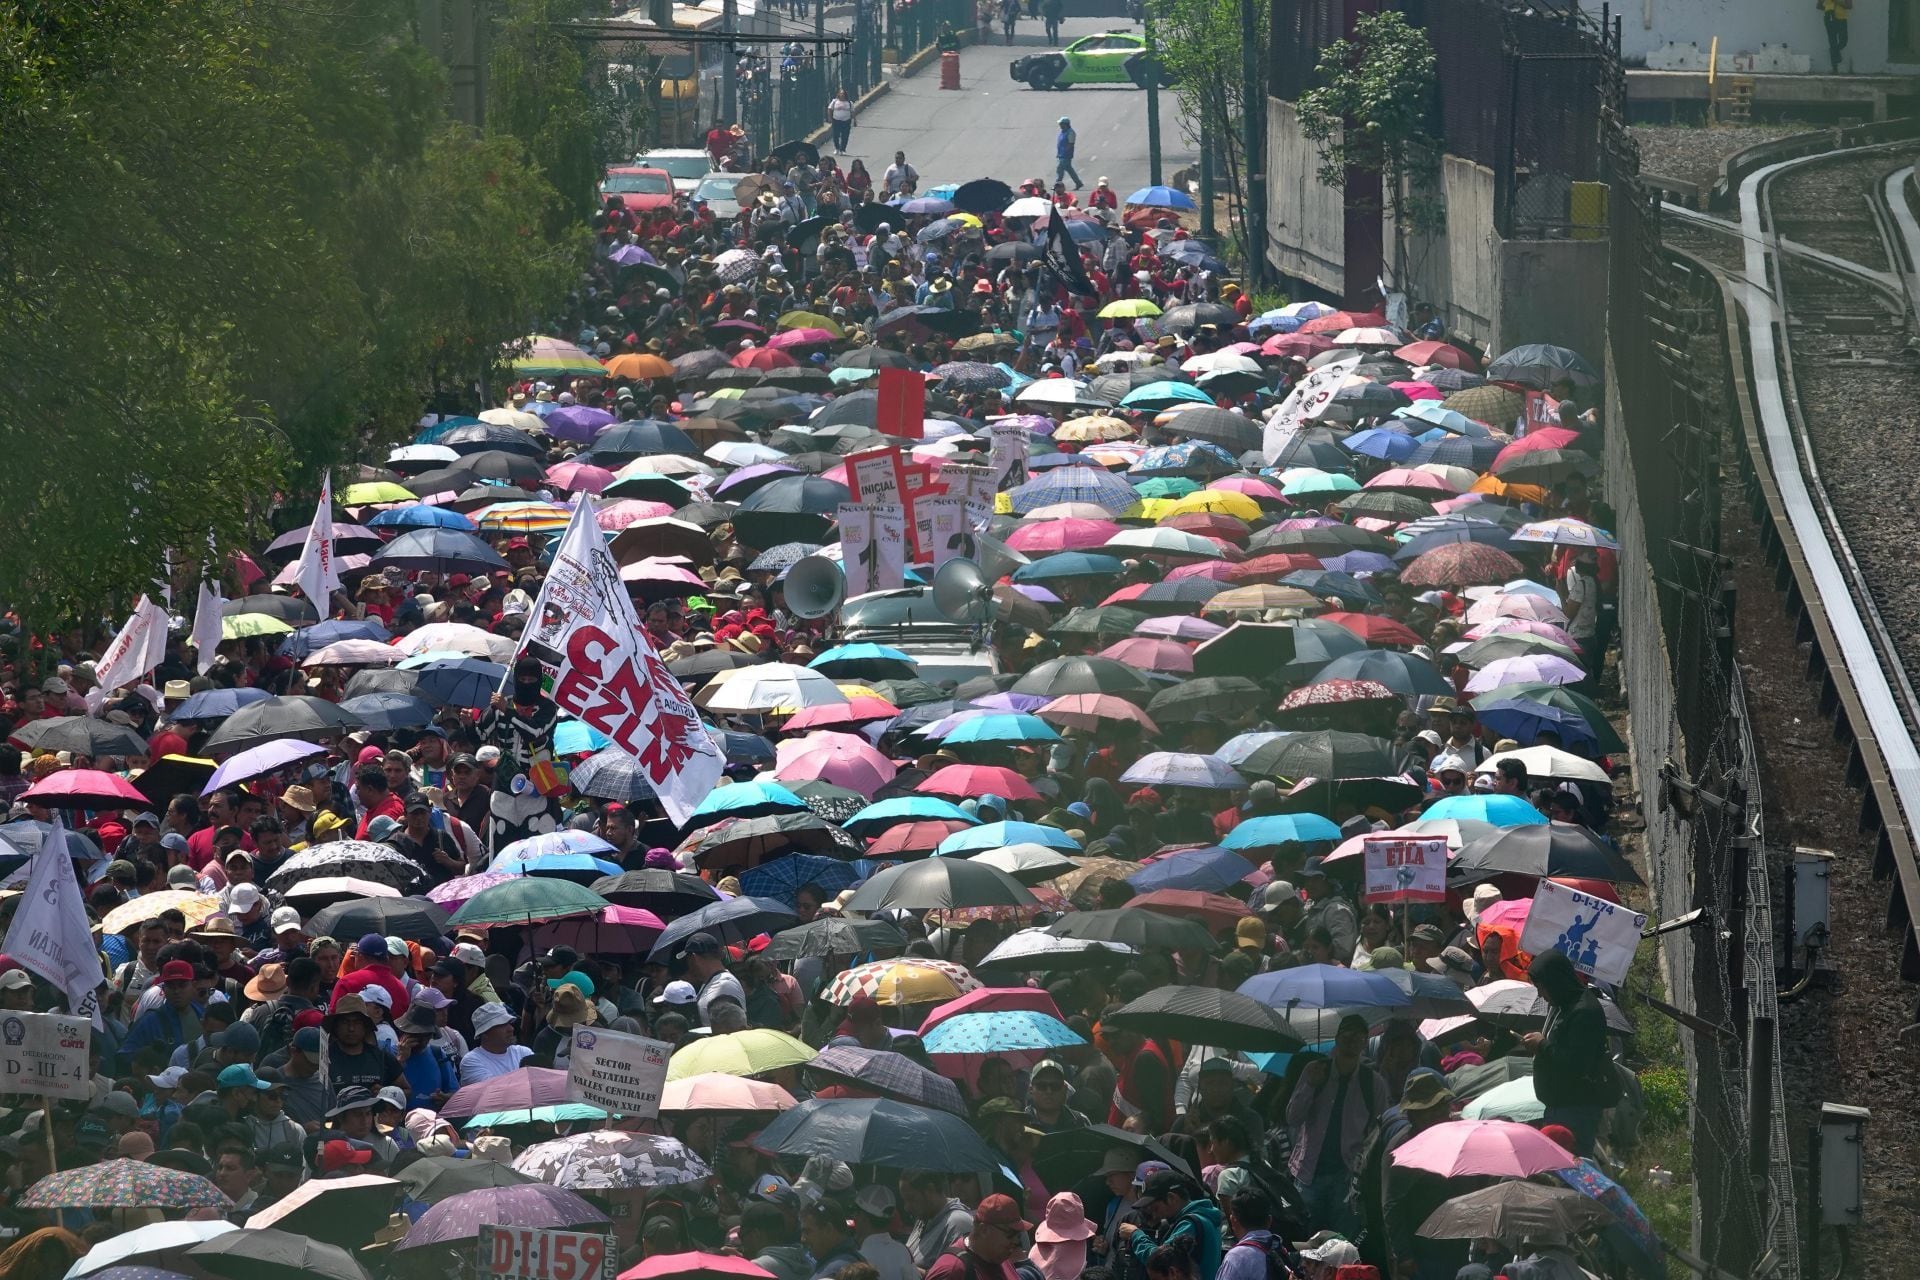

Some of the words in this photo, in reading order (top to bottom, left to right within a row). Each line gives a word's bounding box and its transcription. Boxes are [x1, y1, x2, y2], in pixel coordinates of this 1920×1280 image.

[861, 480, 896, 496] INICIAL
[554, 667, 674, 786] EZLN
[1386, 847, 1425, 867] ETLA
[1572, 892, 1614, 916] D-I-174
[595, 1057, 631, 1071] SECTOR
[591, 1069, 640, 1086] ESTATALES
[573, 1075, 603, 1092] VALLES
[605, 1085, 656, 1102] CENTRALES
[583, 1091, 618, 1109] SECCION
[619, 1101, 641, 1112] XXII
